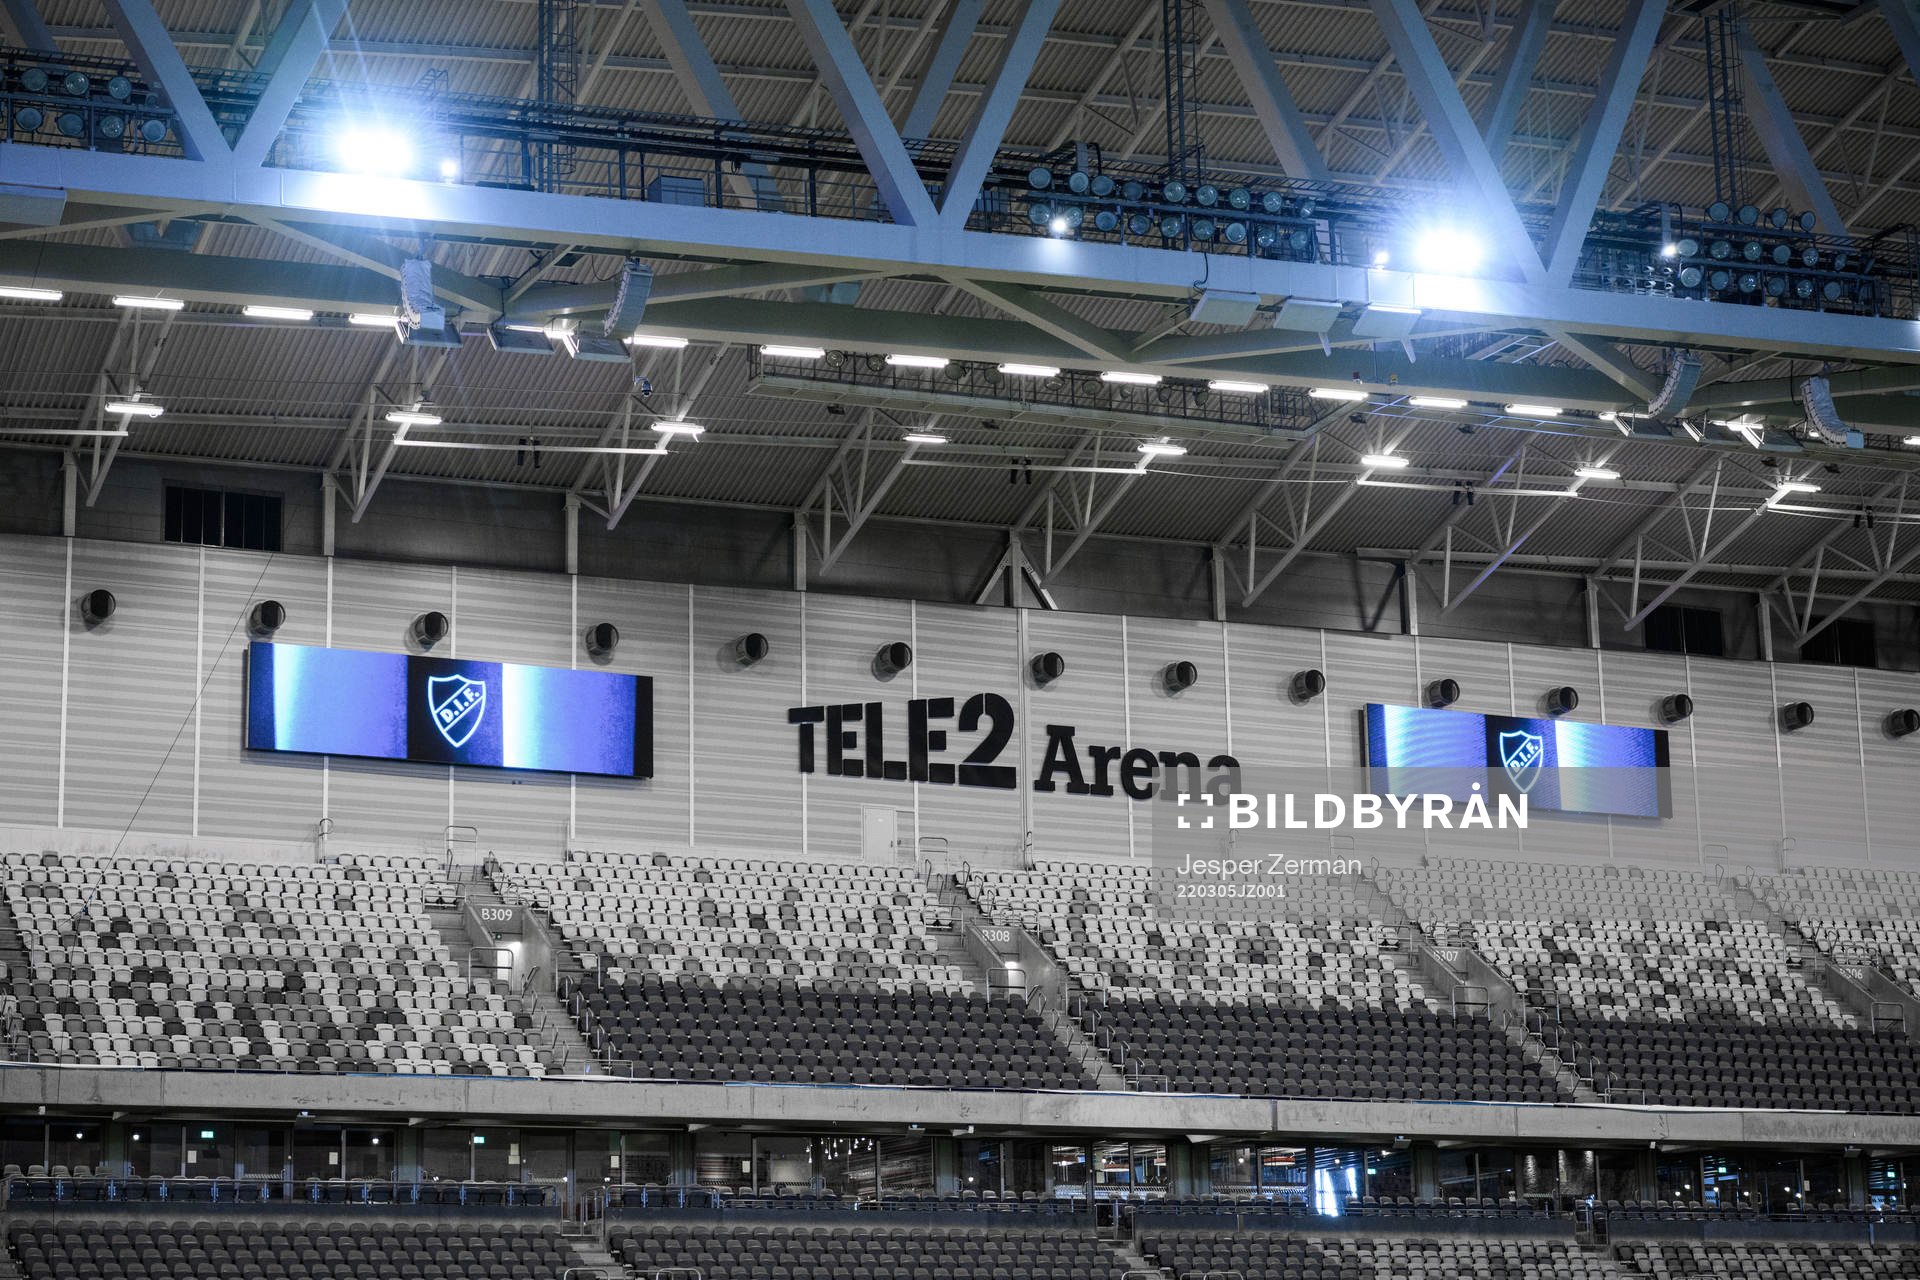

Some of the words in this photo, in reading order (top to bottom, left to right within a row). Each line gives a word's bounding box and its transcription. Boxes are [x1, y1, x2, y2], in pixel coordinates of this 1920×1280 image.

[439, 687, 480, 723] D.I.F.
[788, 692, 1017, 789] TELE2
[1034, 724, 1243, 806] Arena
[481, 908, 513, 921] B309
